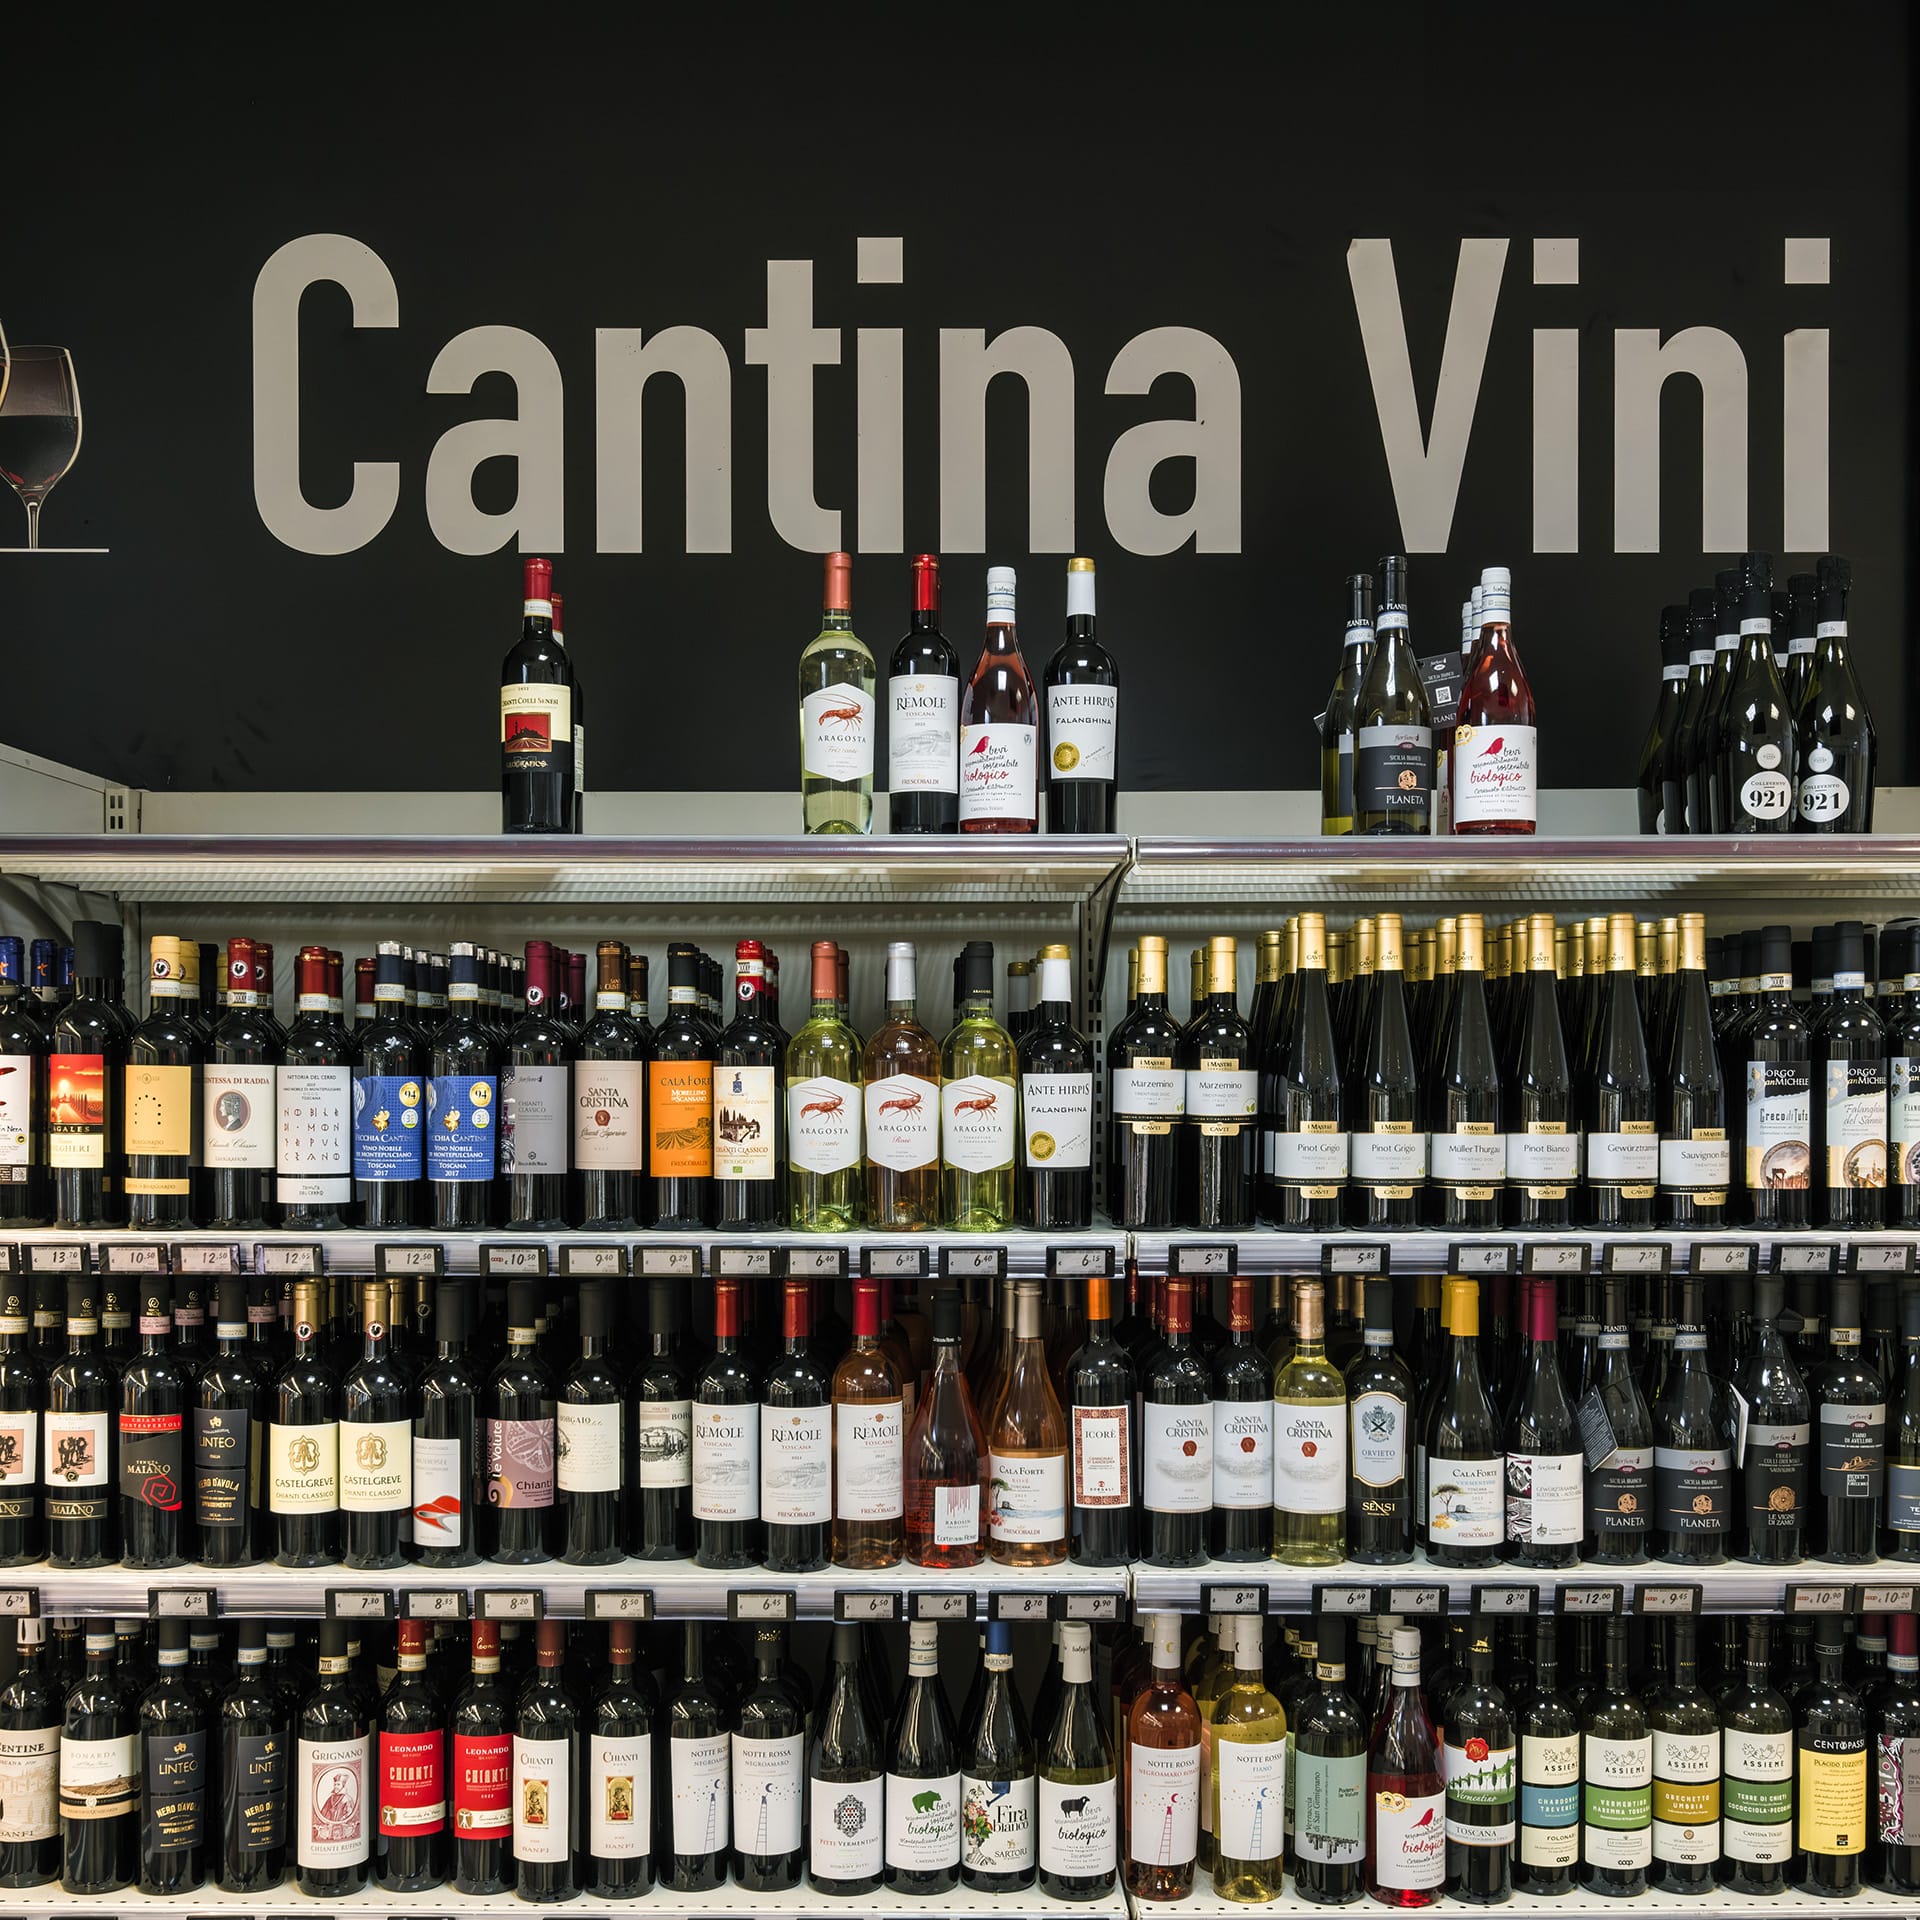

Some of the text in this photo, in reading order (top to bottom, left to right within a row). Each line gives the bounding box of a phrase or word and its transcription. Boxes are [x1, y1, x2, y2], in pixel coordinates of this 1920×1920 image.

[251, 233, 1831, 556] Cantina Vini
[1053, 696, 1114, 708] ANTE HIRPIS
[818, 735, 866, 743] ARAGOSTA
[964, 769, 1008, 784] biologico
[1470, 769, 1522, 786] biologico
[1386, 795, 1424, 805] PLANETA
[1749, 790, 1785, 808] 921
[1803, 792, 1841, 811] 921
[660, 1078, 685, 1086] CALA
[1131, 1080, 1173, 1088] Marzemino
[404, 1090, 416, 1100] 94
[475, 1090, 487, 1099] 94
[588, 1087, 619, 1096] SANTA
[1028, 1084, 1090, 1096] ANTE HIRPIS
[580, 1096, 629, 1108] CRISTINA
[1760, 1108, 1785, 1122] Greco
[1394, 1144, 1415, 1154] Grigio
[1449, 1145, 1473, 1153] Müller
[1524, 1144, 1544, 1152] Pinot
[1681, 1151, 1719, 1160] Sauvignon
[746, 1254, 765, 1267] 7.50
[815, 1254, 835, 1267] 6.40
[974, 1254, 993, 1267] 6.40
[1204, 1252, 1224, 1265] 5.79
[1357, 1251, 1376, 1264] 5.85
[1484, 1251, 1503, 1265] 4.99
[1558, 1251, 1577, 1264] 5.99
[1806, 1251, 1826, 1263] 7.90
[1883, 1251, 1903, 1263] 7.90
[1176, 1419, 1203, 1427] SANTA
[1234, 1416, 1262, 1424] SANTA
[1295, 1420, 1324, 1428] SANTA
[1166, 1427, 1208, 1437] CRISTINA
[1224, 1424, 1268, 1434] CRISTINA
[1287, 1427, 1332, 1438] CRISTINA
[127, 1464, 170, 1476] MAIANO
[999, 1465, 1044, 1475] CALA FORTE
[1452, 1469, 1475, 1477] CALA
[275, 1477, 334, 1488] CASTELGREVE
[344, 1475, 401, 1486] CASTELGREVE
[516, 1479, 552, 1490] Chianti
[302, 1491, 334, 1499] CLASSICO
[52, 1504, 94, 1517] MAIANO
[1362, 1501, 1395, 1514] SENSI
[1606, 1517, 1645, 1526] PLANETA
[1681, 1518, 1720, 1528] PLANETA
[1415, 1592, 1435, 1605] 6.40
[1506, 1592, 1525, 1606] 8.70
[1585, 1592, 1611, 1605] 12.00
[1815, 1592, 1841, 1604] 10.90
[1884, 1591, 1910, 1603] 10.20
[510, 1597, 529, 1610] 8.20
[869, 1598, 889, 1611] 6.50
[943, 1598, 962, 1611] 6.98
[1024, 1599, 1043, 1612] 8.70
[1092, 1599, 1111, 1612] 9.90
[390, 1744, 433, 1752] LEONARDO
[466, 1746, 509, 1755] LEONARDO
[743, 1750, 791, 1758] NOTTE ROSSA
[312, 1749, 362, 1760] GRIGNANO
[520, 1753, 553, 1765] CHIANTI
[603, 1752, 638, 1763] CHIANTI
[1743, 1760, 1784, 1768] ASSIEME
[1814, 1759, 1840, 1768] PLACIDO
[390, 1765, 433, 1781] CHIANTI
[1605, 1766, 1645, 1774] ASSIEME
[1456, 1790, 1497, 1802] Vermentino
[1665, 1793, 1710, 1801] GRECHETTO
[1738, 1793, 1758, 1801] TERRE
[156, 1804, 176, 1818] NERO
[244, 1802, 264, 1818] NERO
[996, 1805, 1027, 1823] Fira
[1593, 1806, 1625, 1815] MAREMMA
[908, 1823, 954, 1838] biologico
[993, 1819, 1028, 1832] bianco
[1456, 1827, 1496, 1836] TOSCANA
[1058, 1827, 1107, 1844] biologico
[995, 1848, 1027, 1857] SARTORI
[1402, 1838, 1444, 1855] biologico
